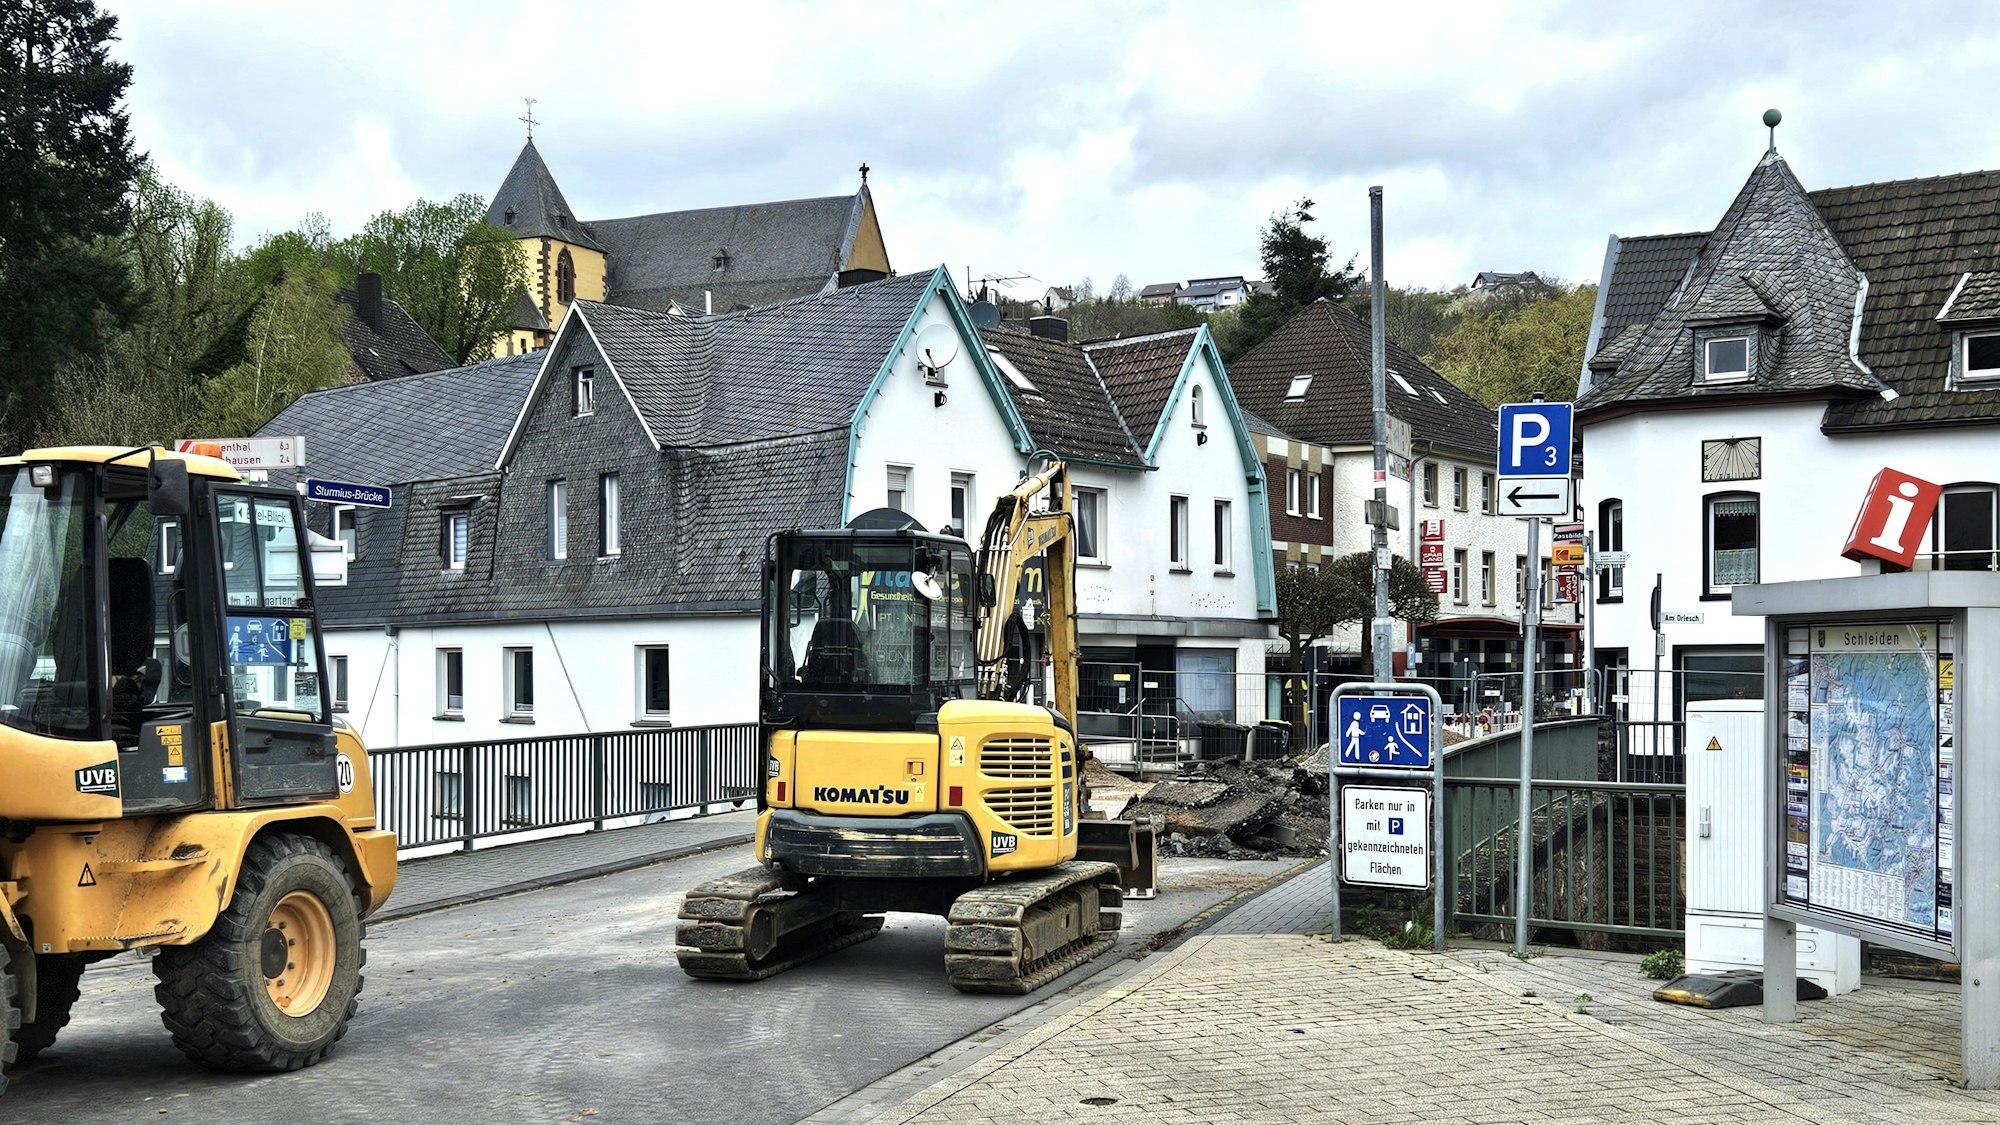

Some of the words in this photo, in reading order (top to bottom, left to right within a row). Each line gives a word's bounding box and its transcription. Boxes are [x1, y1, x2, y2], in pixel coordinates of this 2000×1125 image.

[221, 442, 251, 452] enthal
[1511, 413, 1551, 468] P
[1544, 446, 1557, 467] 3
[222, 455, 262, 466] hausen
[314, 484, 384, 503] Sturmius-Brücke
[246, 507, 287, 524] Eel-Blick
[1665, 614, 1675, 622] Am
[1843, 631, 1900, 646] Schleiden
[79, 768, 116, 786] UVB
[337, 760, 352, 786] 20
[814, 785, 909, 805] KOMATSU
[1354, 797, 1385, 812] Parken
[1388, 801, 1403, 812] nur
[1407, 800, 1415, 812] in
[1366, 819, 1381, 832] mit
[992, 835, 1016, 848] UVB
[1347, 840, 1424, 855] gekennzeichneten
[1369, 861, 1402, 875] Flächen
